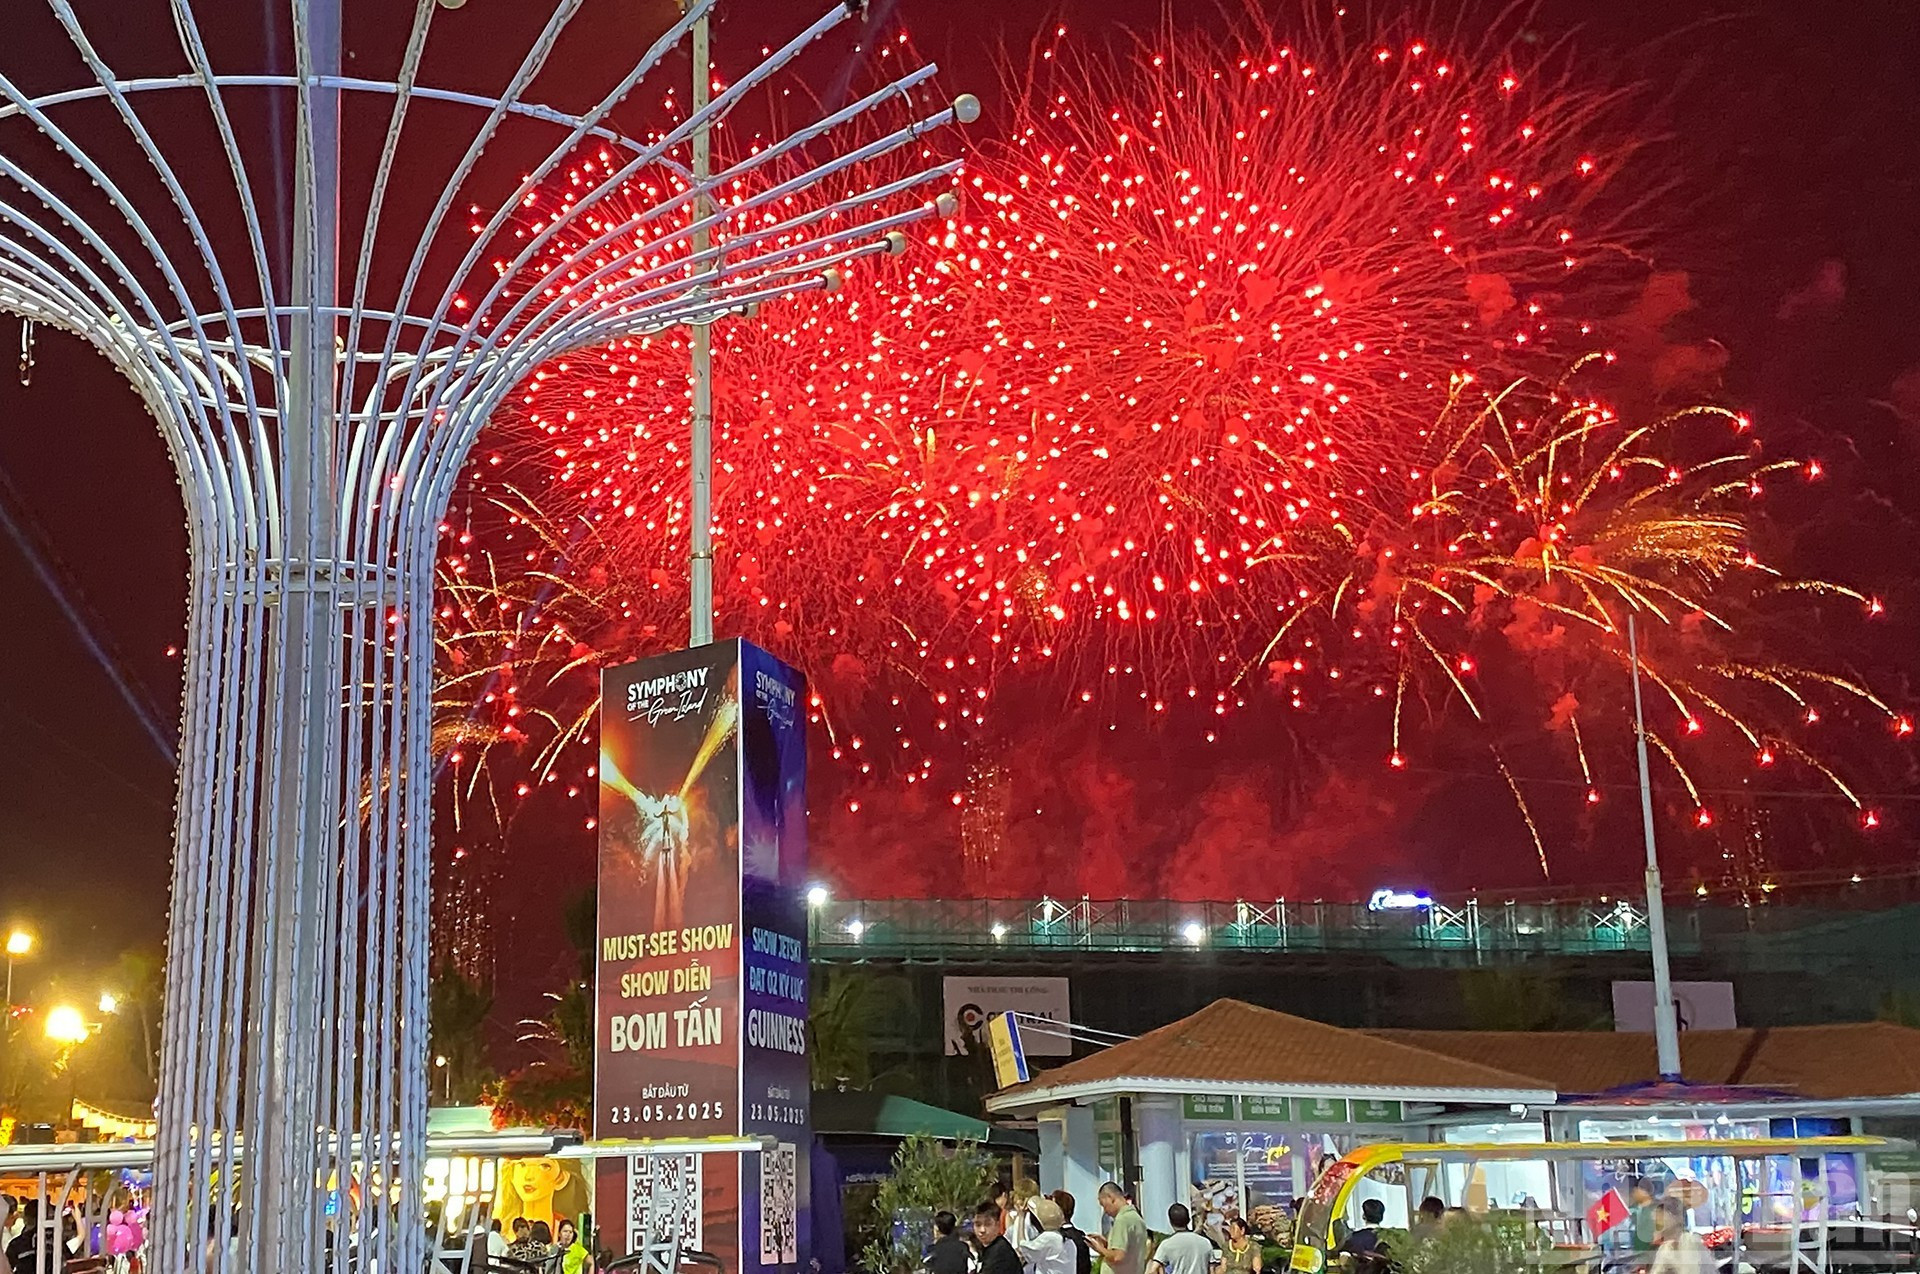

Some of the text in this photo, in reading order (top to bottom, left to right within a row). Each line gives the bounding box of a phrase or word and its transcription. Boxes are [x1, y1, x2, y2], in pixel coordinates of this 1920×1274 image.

[628, 667, 709, 702] SYMPHONY
[627, 700, 649, 712] OF THE
[603, 923, 733, 962] MUST-SEE SHOW
[752, 926, 778, 957] SHOW
[621, 958, 711, 999] SHOW DIỄN
[767, 970, 778, 996] 02
[611, 995, 722, 1053] BOM TẤN
[748, 1008, 806, 1056] GUINNESS
[611, 1101, 723, 1124] 23.05.2025
